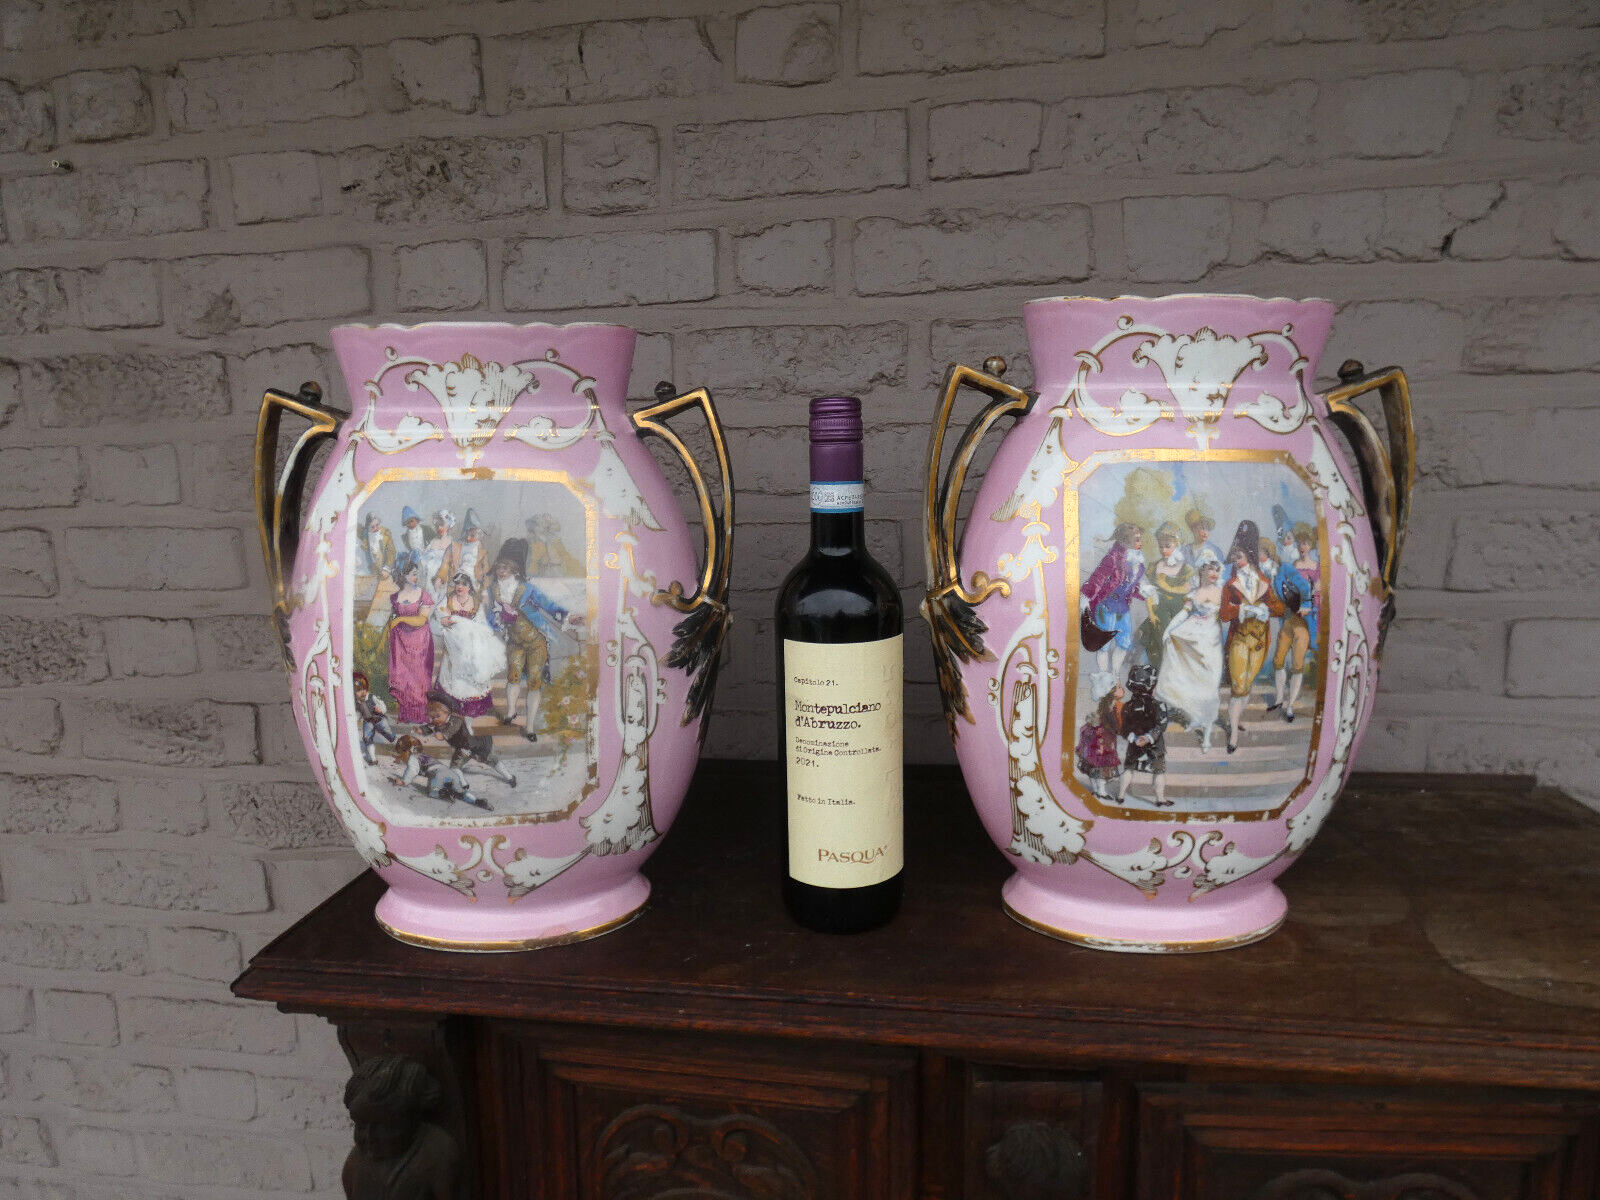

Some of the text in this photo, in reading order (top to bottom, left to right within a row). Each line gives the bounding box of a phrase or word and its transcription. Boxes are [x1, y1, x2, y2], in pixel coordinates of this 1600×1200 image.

[794, 677, 825, 686] Capitolo
[795, 700, 881, 716] Montepulciano
[795, 716, 861, 729] d'Abruzzo.
[796, 737, 849, 747] Denominazione
[803, 747, 833, 757] Origine
[834, 746, 882, 756] Controllata.
[796, 757, 819, 768] 2021.
[797, 794, 815, 804] Fatto
[818, 847, 884, 864] PASQUA
